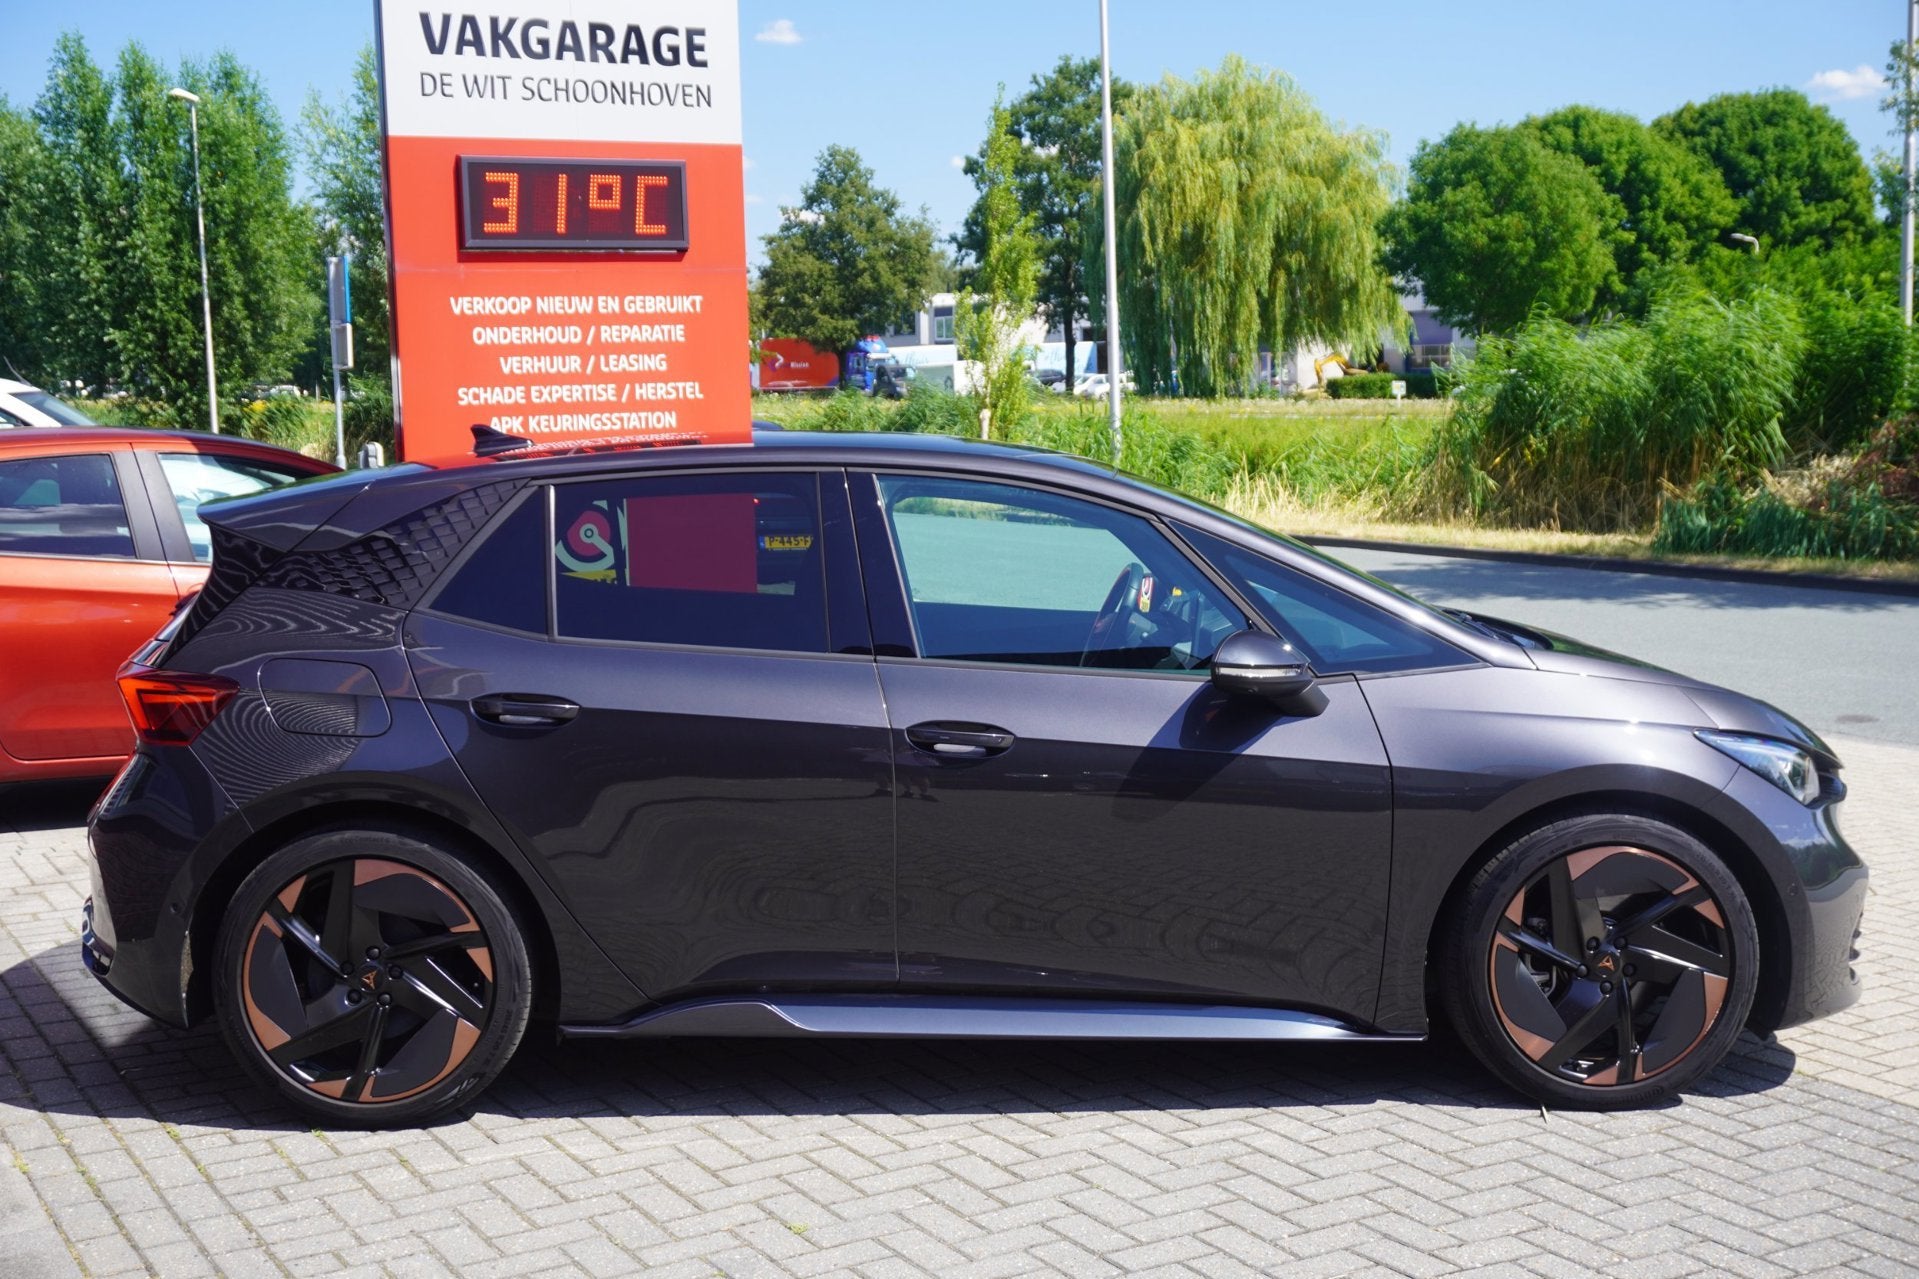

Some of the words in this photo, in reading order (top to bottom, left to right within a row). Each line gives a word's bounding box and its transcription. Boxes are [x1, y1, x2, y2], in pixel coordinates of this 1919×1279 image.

[418, 11, 709, 68] VAKGARAGE
[420, 71, 454, 98] DE
[462, 73, 512, 100] WIT
[521, 76, 712, 108] SCHOONHOVEN
[449, 296, 532, 315] VERKOOP
[536, 296, 594, 314] NIEUW
[597, 295, 620, 314] EN
[623, 295, 703, 314] GEBRUIKT
[472, 326, 582, 345] ONDERHOUD
[586, 325, 596, 346] /
[600, 324, 686, 343] REPARATIE
[499, 355, 582, 375] VERHUUR
[585, 354, 595, 375] /
[600, 353, 668, 373] LEASING
[457, 386, 526, 406] SCHADE
[530, 383, 617, 404] EXPERTISE
[621, 383, 630, 403] /
[635, 381, 704, 400] HERSTEL
[490, 415, 525, 434] APK
[528, 410, 677, 433] KEURINGSSTATION
